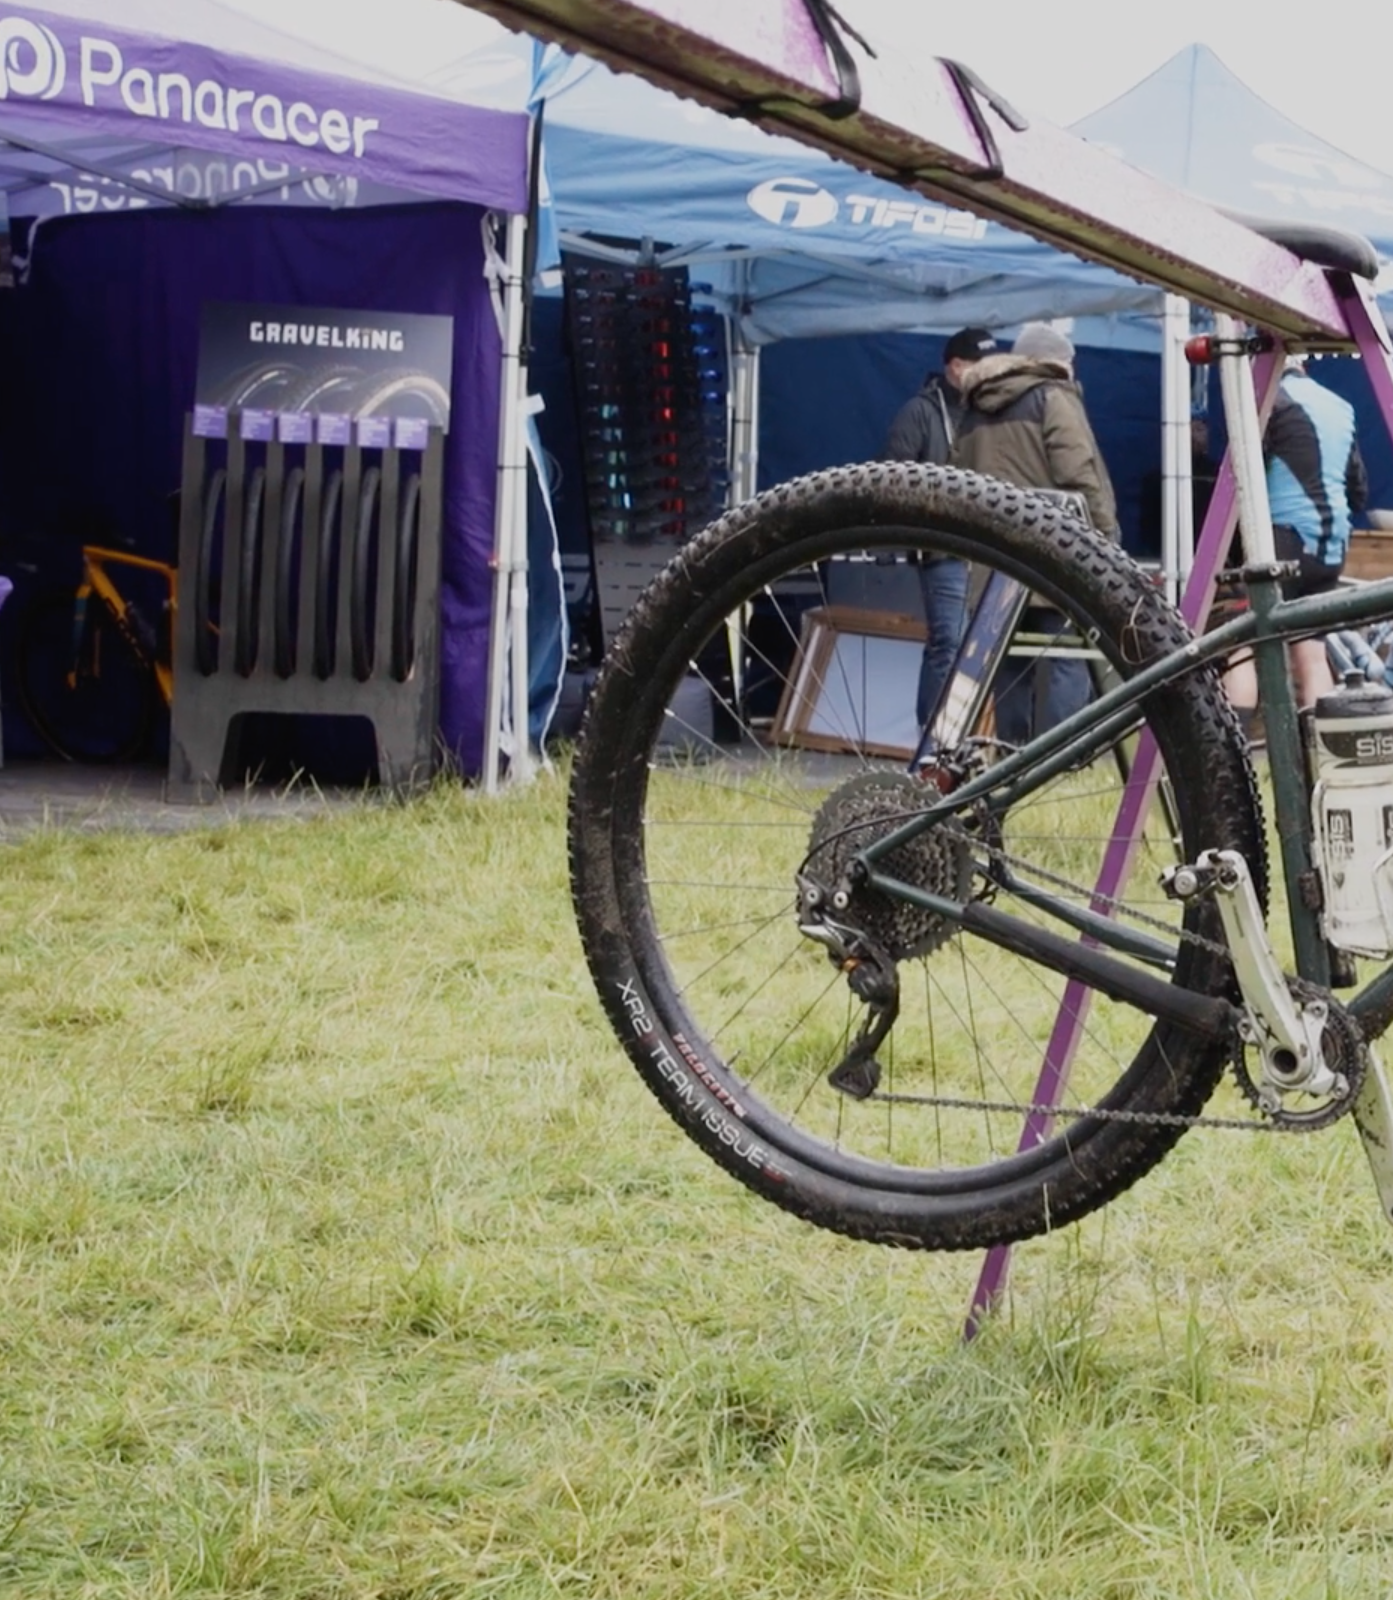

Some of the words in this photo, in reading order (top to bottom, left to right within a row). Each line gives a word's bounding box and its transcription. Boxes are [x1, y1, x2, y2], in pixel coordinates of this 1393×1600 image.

[80, 37, 379, 158] Panaracer
[844, 195, 987, 240] TIFOSI
[616, 977, 653, 1038] XR2
[650, 1040, 704, 1112] TEAM
[701, 1106, 769, 1170] ISSUE
